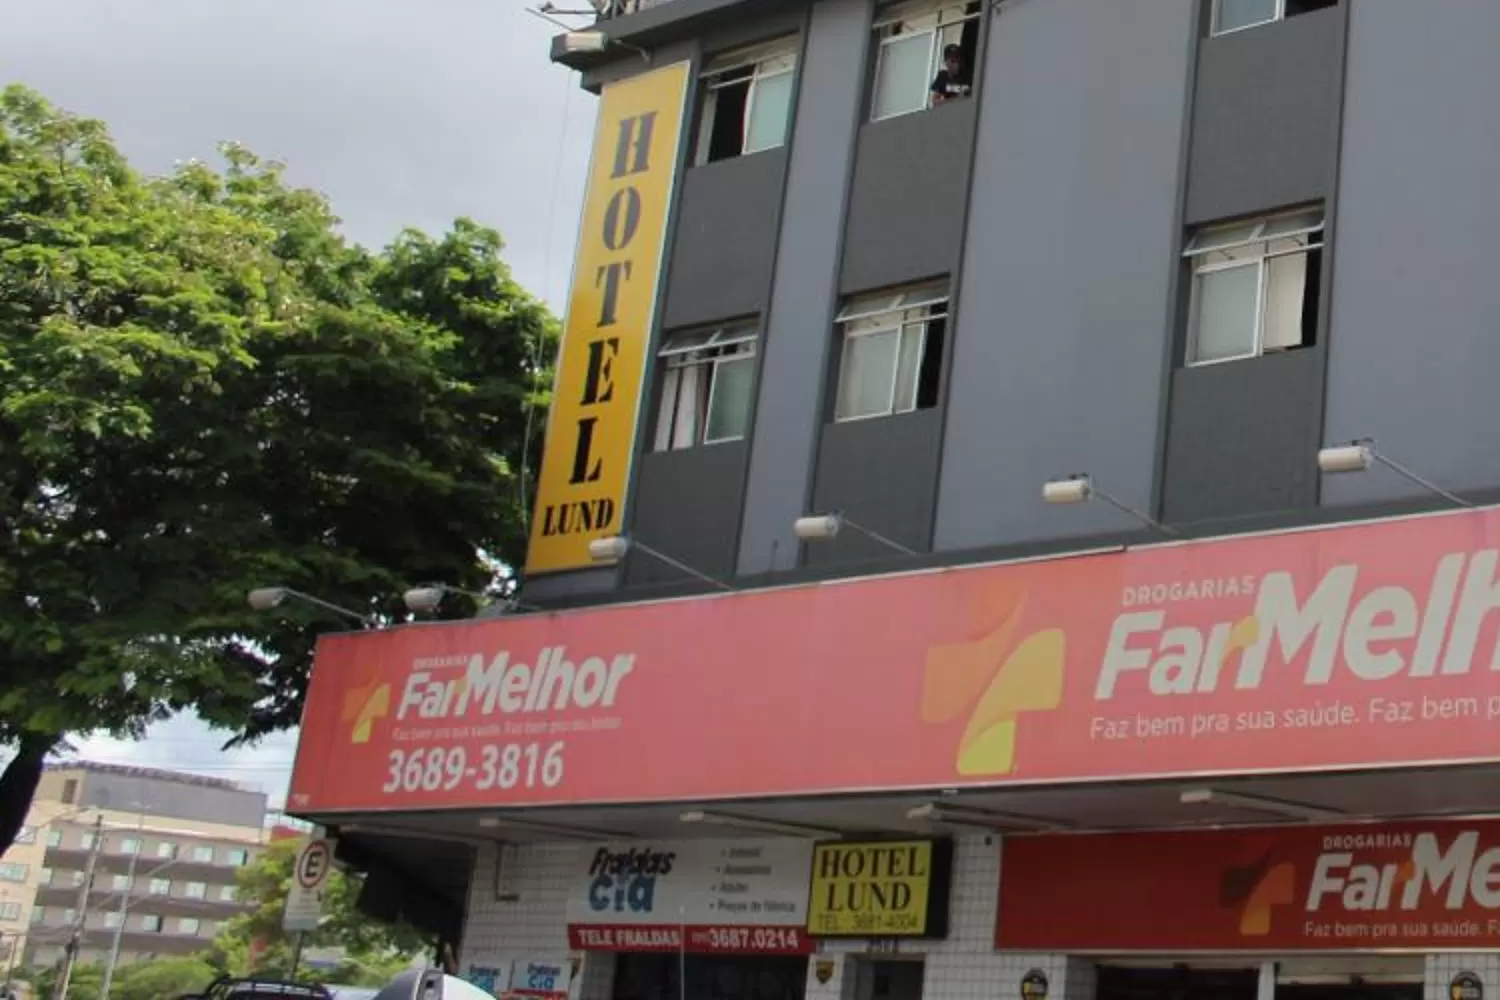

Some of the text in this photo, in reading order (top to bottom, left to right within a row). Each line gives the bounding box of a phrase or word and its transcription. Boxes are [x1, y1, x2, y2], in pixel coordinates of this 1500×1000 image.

[569, 111, 659, 486] HOTEL
[542, 497, 615, 537] LUND
[1122, 574, 1256, 607] DROGARIAS
[397, 645, 637, 720] FarMelhor
[1090, 716, 1128, 741] Faz
[1136, 712, 1184, 738] bem
[1191, 712, 1231, 738] pra
[1235, 709, 1275, 730] sua
[1283, 700, 1360, 729] saúde.
[1368, 697, 1414, 722] Faz
[1421, 696, 1477, 720] bem
[382, 740, 565, 792] 3689-3816
[1323, 833, 1412, 850] DROGARIAS
[304, 851, 323, 878] E
[820, 846, 926, 878] HOTEL
[827, 881, 912, 912] LUND
[577, 928, 614, 946] TELE
[616, 928, 681, 947] FRALDAS
[709, 927, 799, 949] 3687.0214
[1304, 921, 1331, 937] Faz
[1335, 920, 1368, 937] bem
[1372, 923, 1397, 939] pra
[1403, 922, 1428, 937] sua
